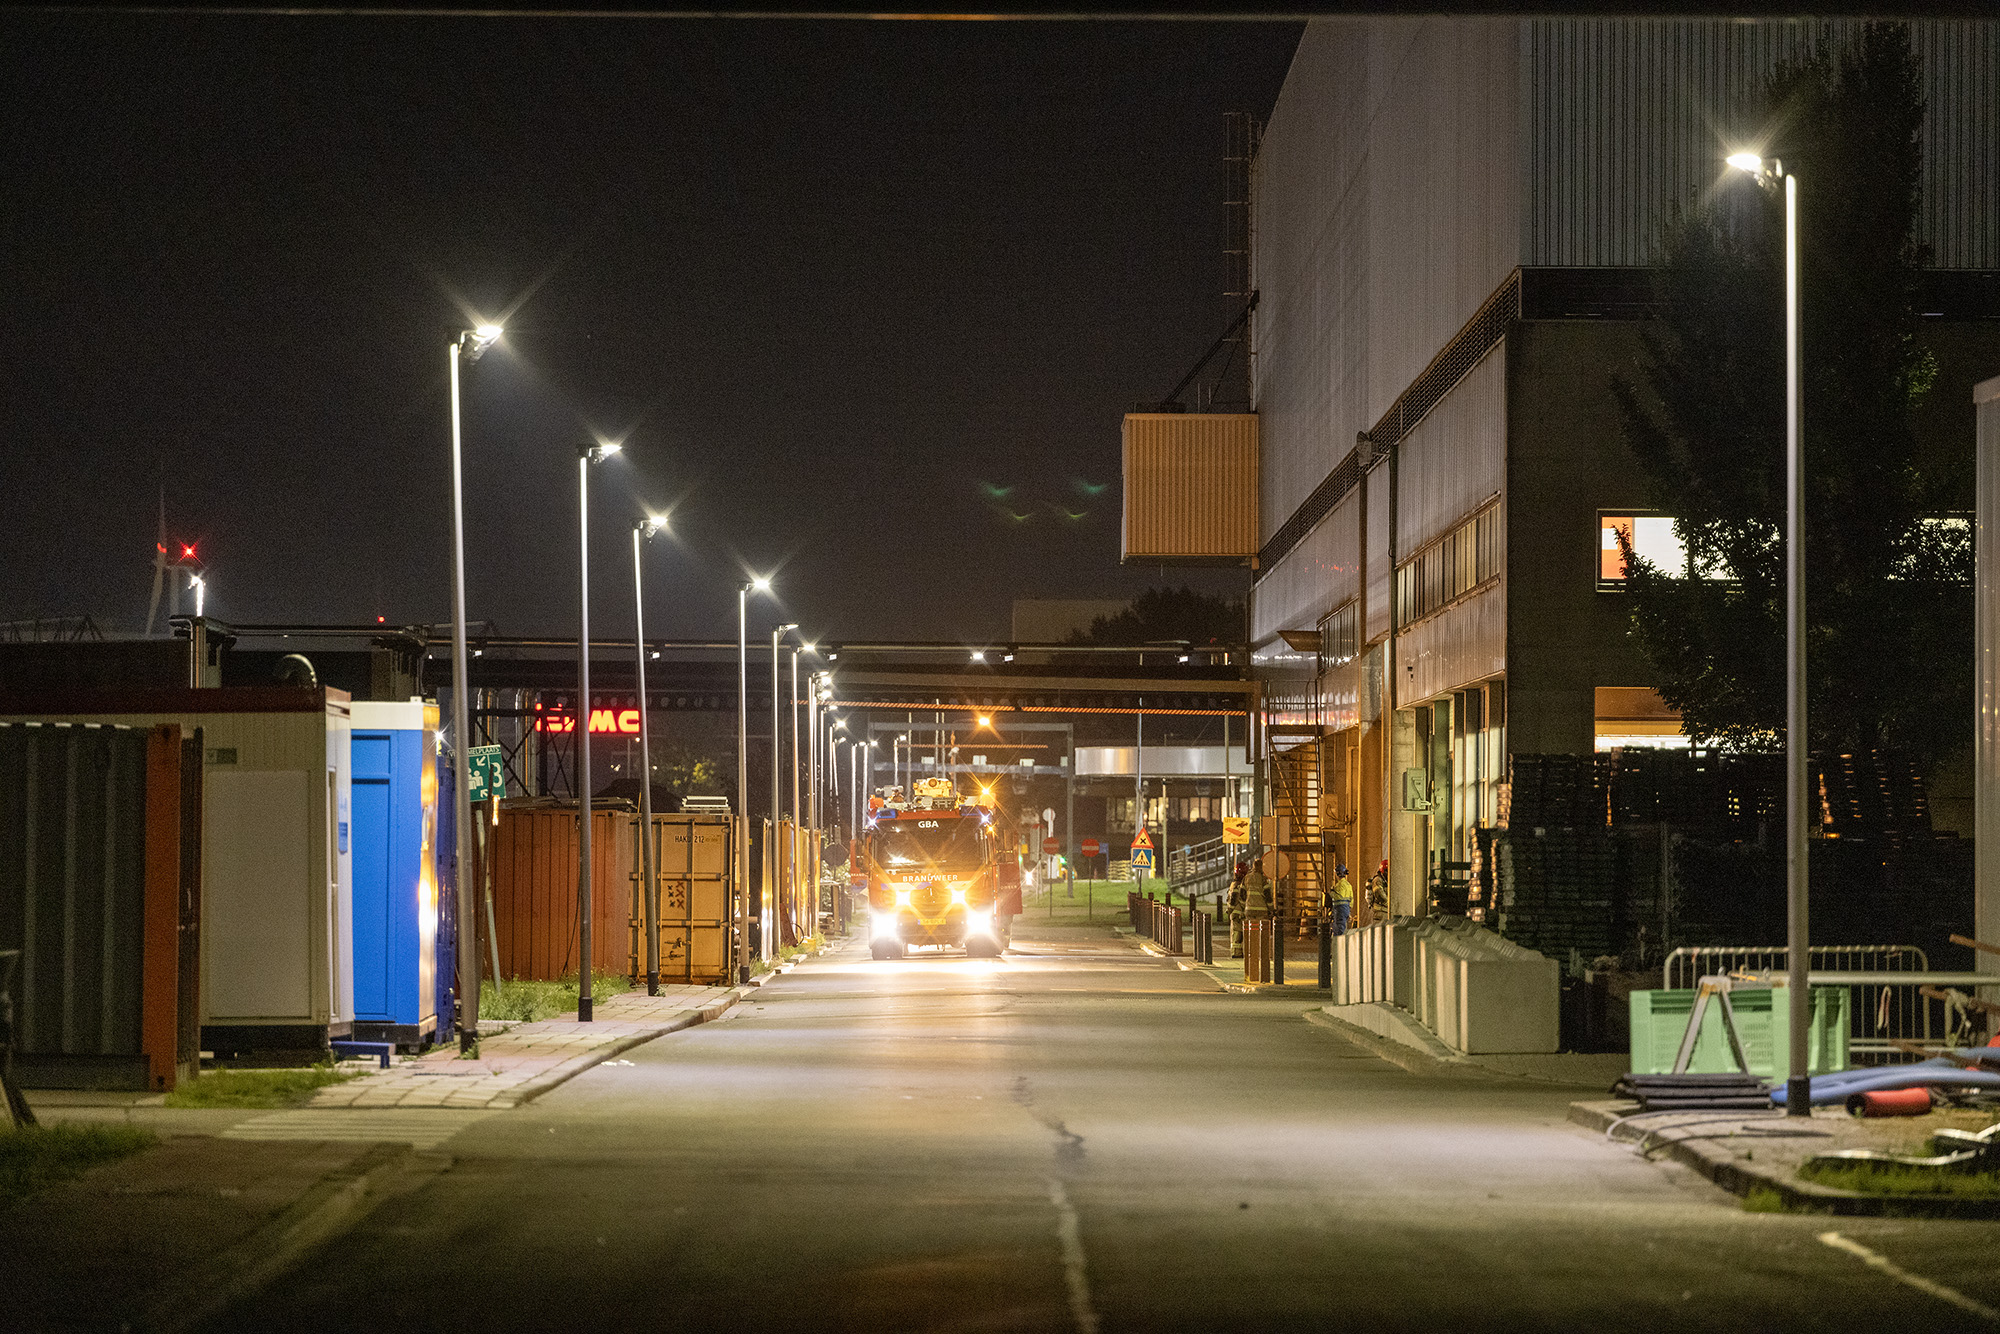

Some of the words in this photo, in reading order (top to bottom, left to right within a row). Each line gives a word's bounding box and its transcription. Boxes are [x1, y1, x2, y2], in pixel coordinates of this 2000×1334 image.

[490, 762, 503, 788] 3
[918, 820, 939, 828] GBA
[902, 874, 958, 882] BRANDWEER
